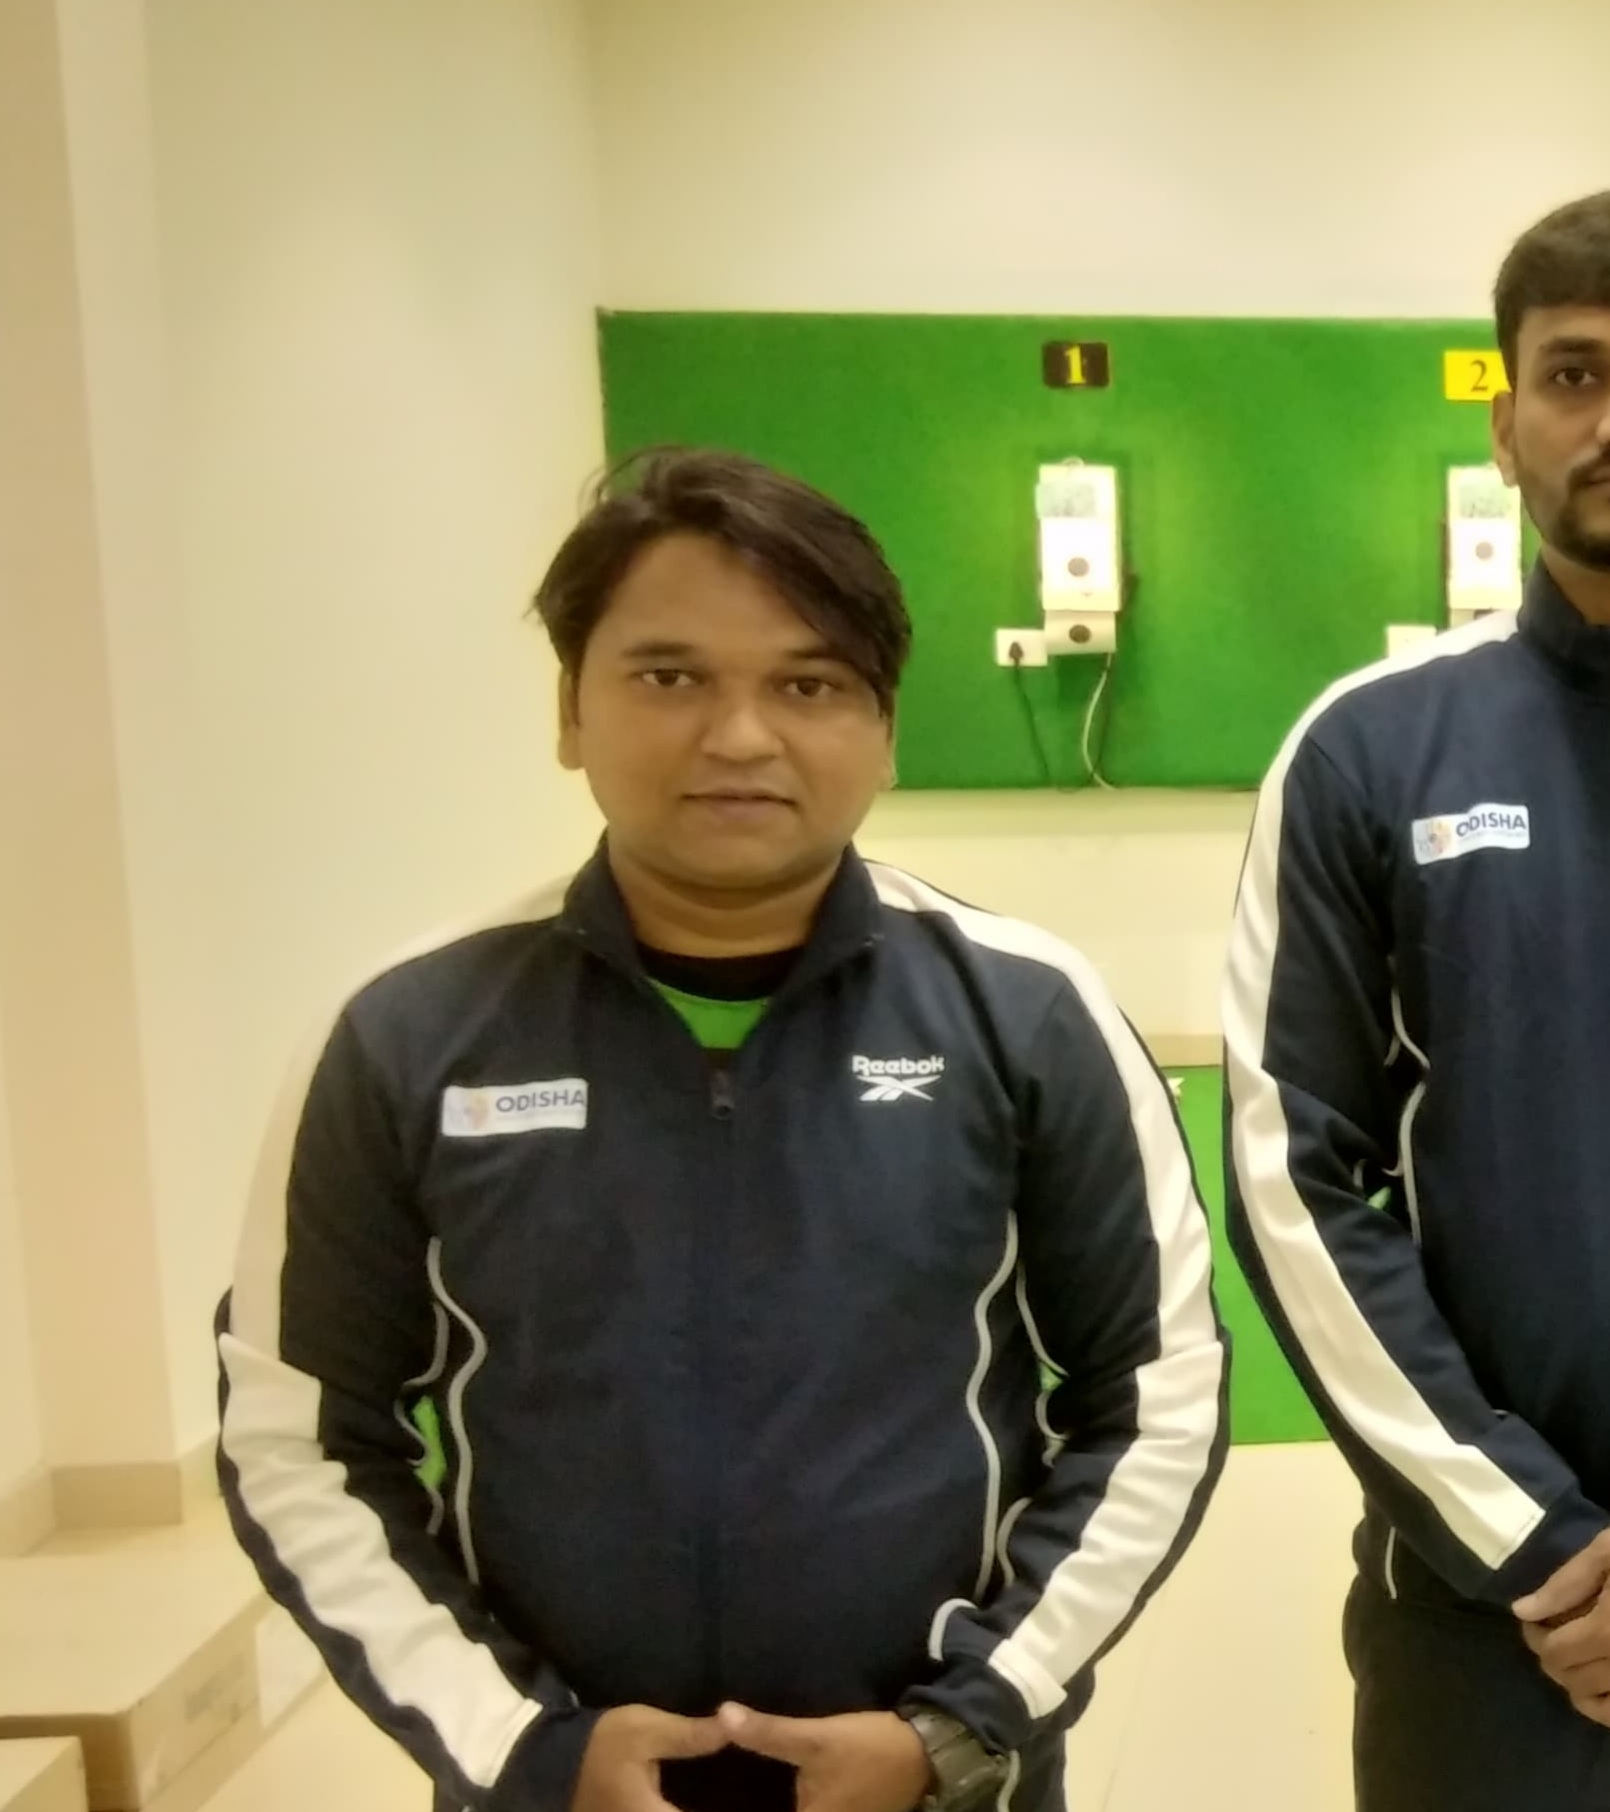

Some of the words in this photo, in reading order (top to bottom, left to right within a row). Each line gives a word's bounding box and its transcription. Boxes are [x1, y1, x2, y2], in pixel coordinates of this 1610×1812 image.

[1064, 344, 1087, 385] 1
[1469, 358, 1489, 393] 2
[1455, 811, 1527, 838] ODISHA
[851, 1054, 945, 1077] Reebok
[495, 1089, 585, 1113] ODISHA
